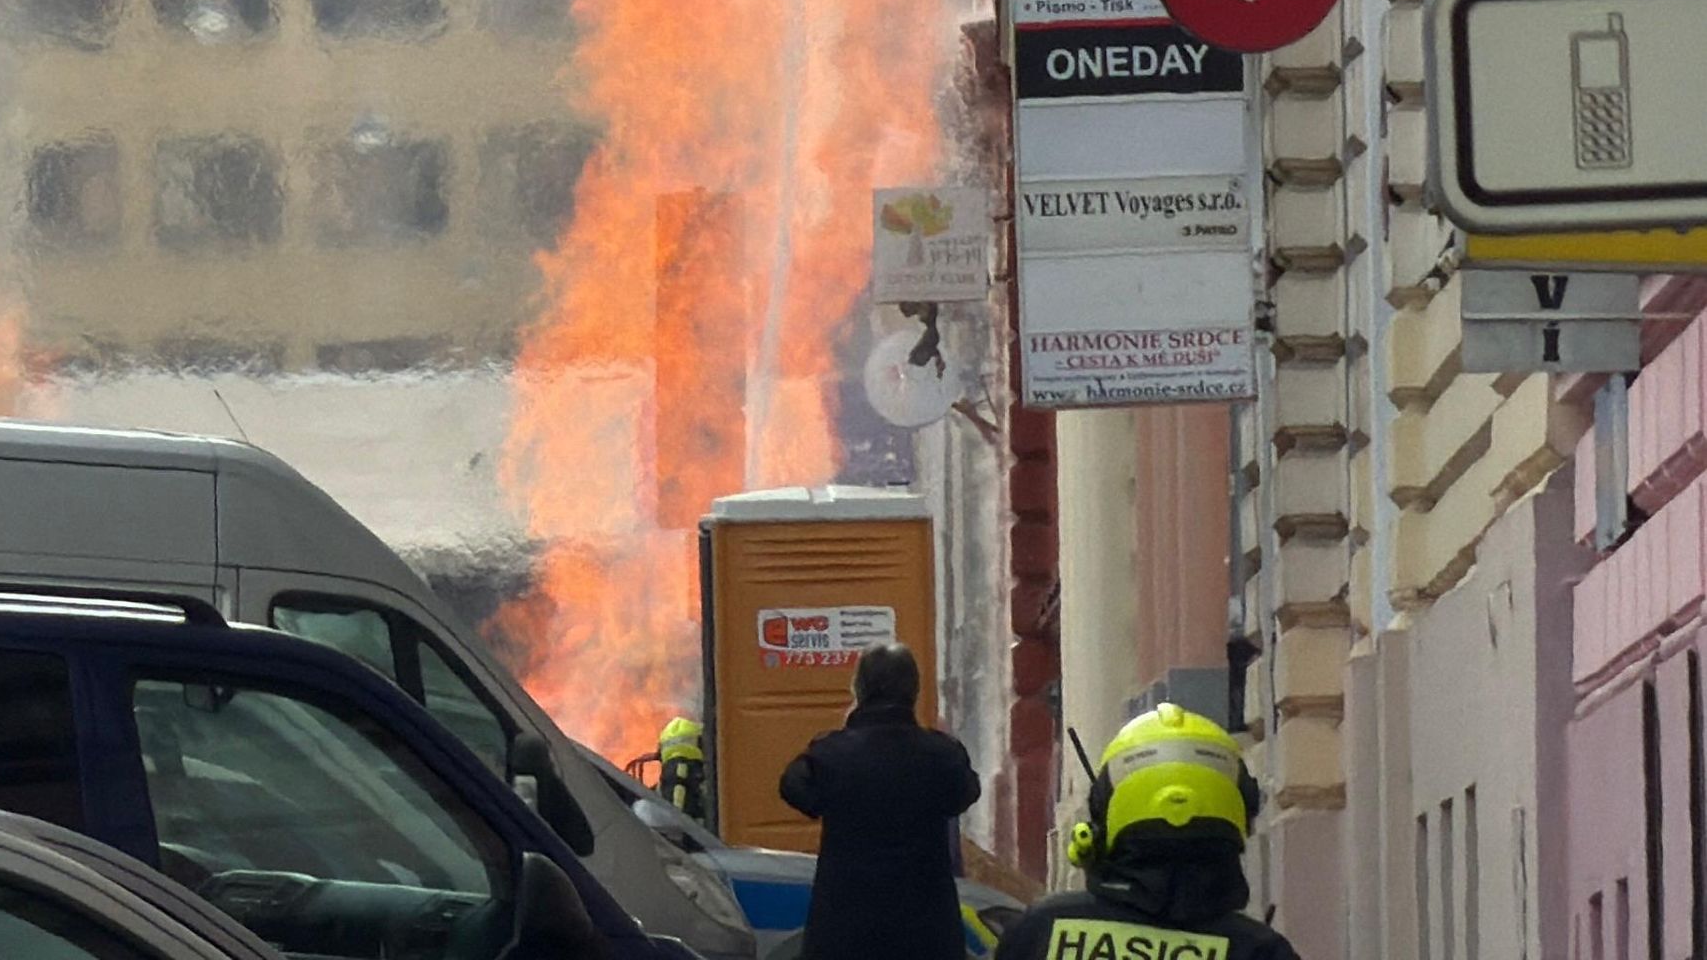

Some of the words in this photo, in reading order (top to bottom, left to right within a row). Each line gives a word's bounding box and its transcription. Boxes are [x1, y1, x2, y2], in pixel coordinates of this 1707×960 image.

[1046, 44, 1209, 81] ONEDAY
[1023, 191, 1110, 217] VELVET
[1115, 191, 1194, 219] Voyages
[1031, 332, 1161, 353] HARMONIE
[1168, 330, 1244, 349] SRDCE
